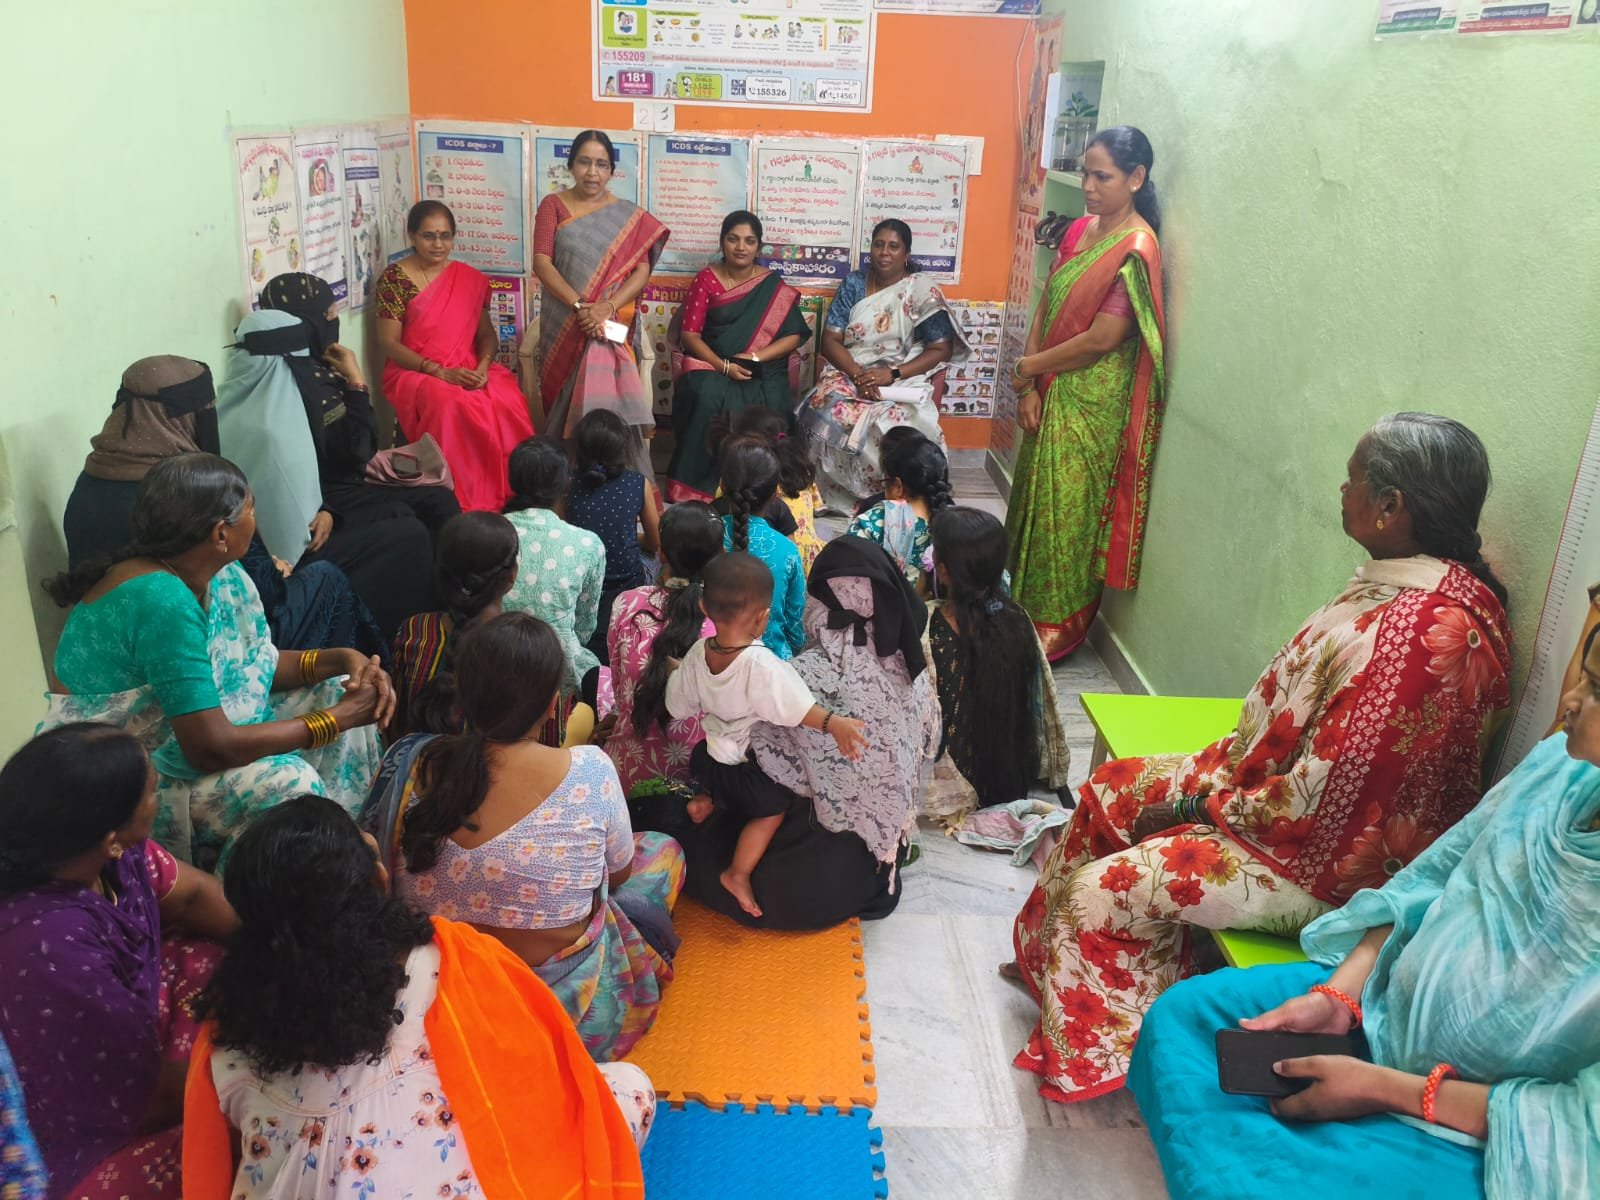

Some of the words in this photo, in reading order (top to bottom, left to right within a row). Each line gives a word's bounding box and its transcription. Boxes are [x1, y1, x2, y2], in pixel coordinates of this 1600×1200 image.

[612, 51, 646, 62] 155209
[626, 72, 646, 82] 181
[757, 87, 787, 97] 155326
[445, 139, 465, 147] ICDS
[671, 142, 692, 150] ICDS
